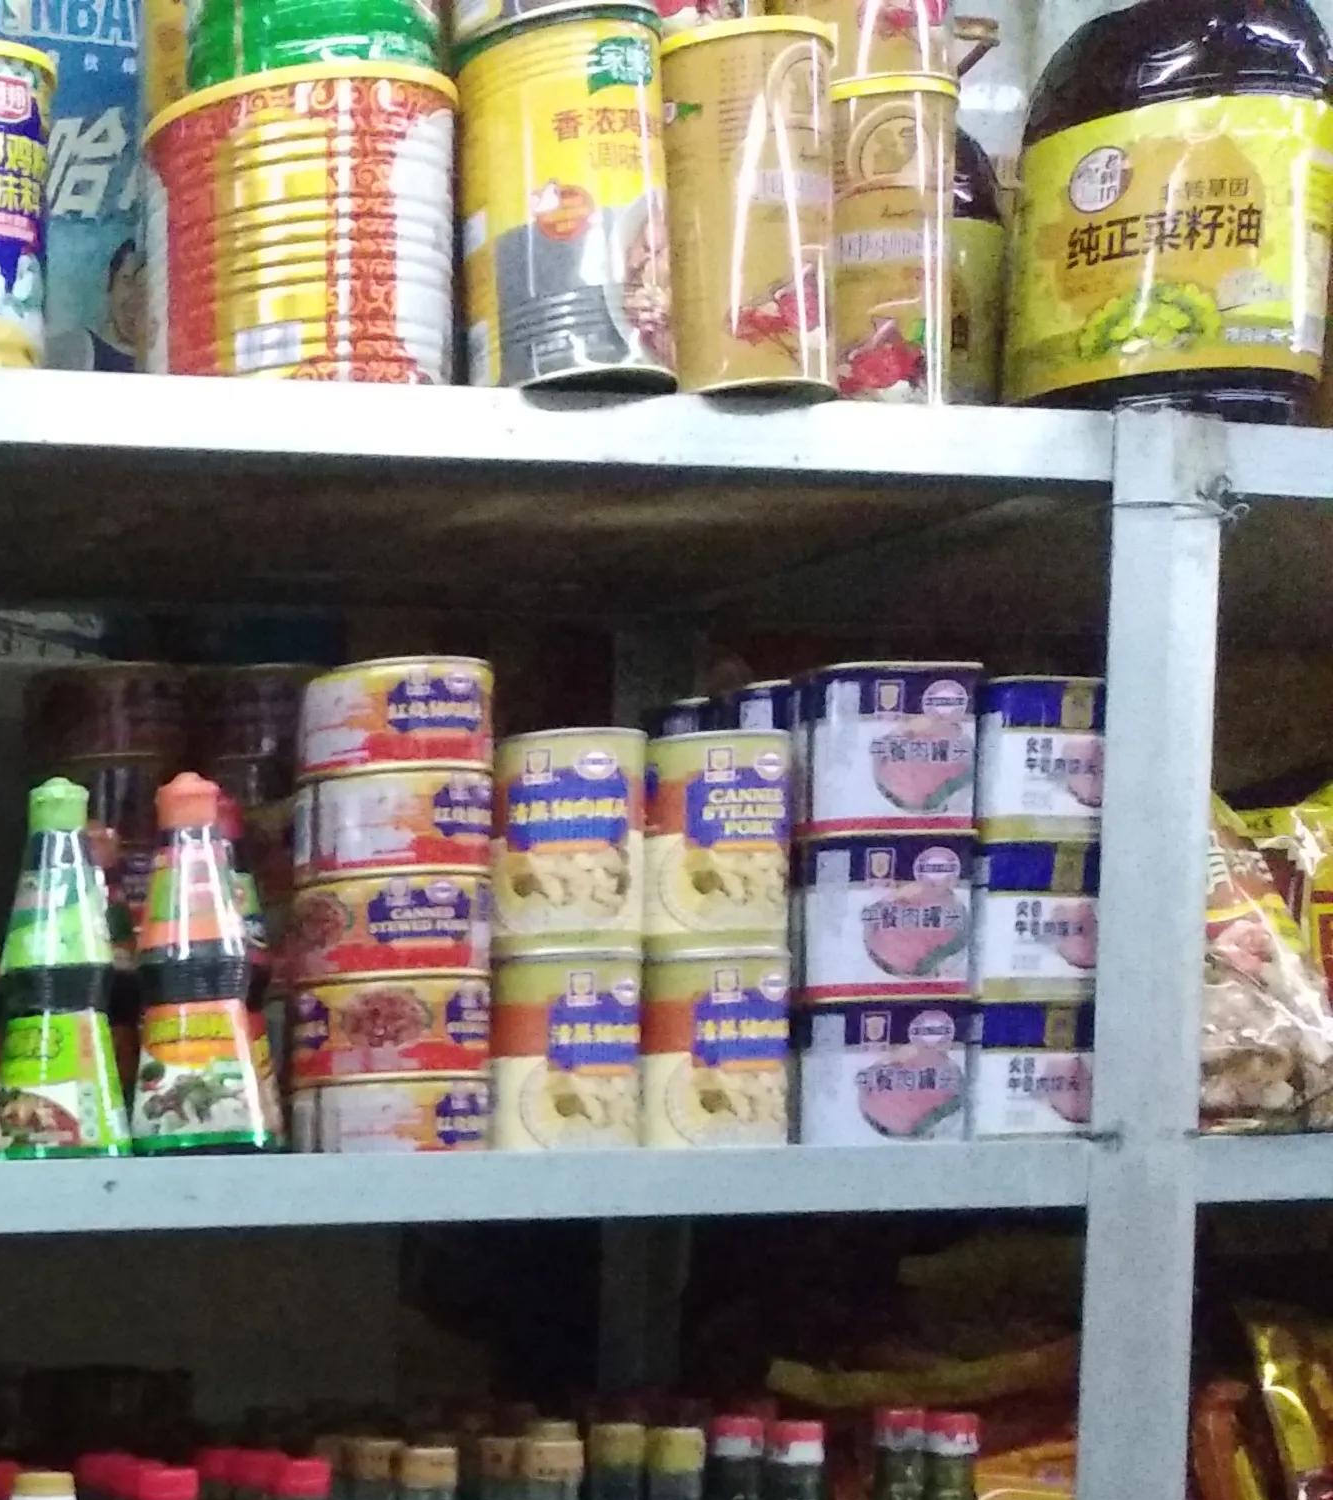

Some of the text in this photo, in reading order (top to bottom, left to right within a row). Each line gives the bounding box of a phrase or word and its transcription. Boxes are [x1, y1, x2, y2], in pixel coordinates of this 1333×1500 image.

[47, 106, 125, 217] 哈
[1065, 206, 1263, 270] 纯正菜籽油
[724, 820, 776, 835] PORK
